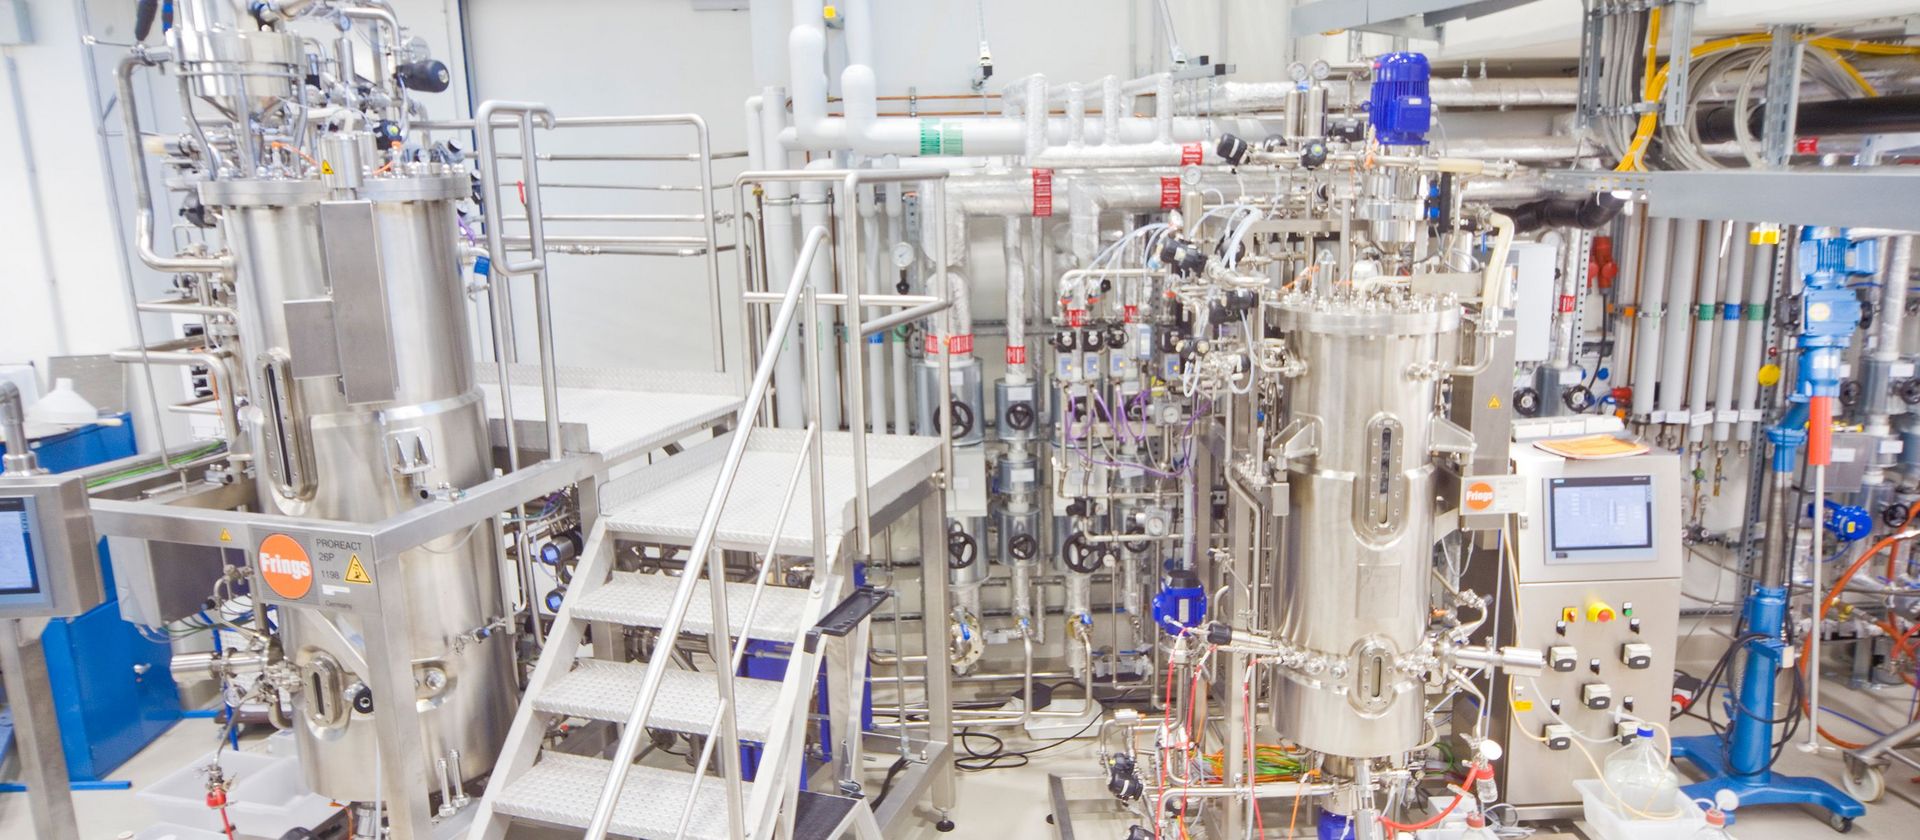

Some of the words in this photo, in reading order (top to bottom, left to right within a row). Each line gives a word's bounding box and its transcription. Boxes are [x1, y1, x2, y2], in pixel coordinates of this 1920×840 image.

[1466, 490, 1493, 502] Frings
[316, 538, 362, 551] PROREACT
[318, 552, 335, 562] 26P
[259, 552, 311, 580] Frings
